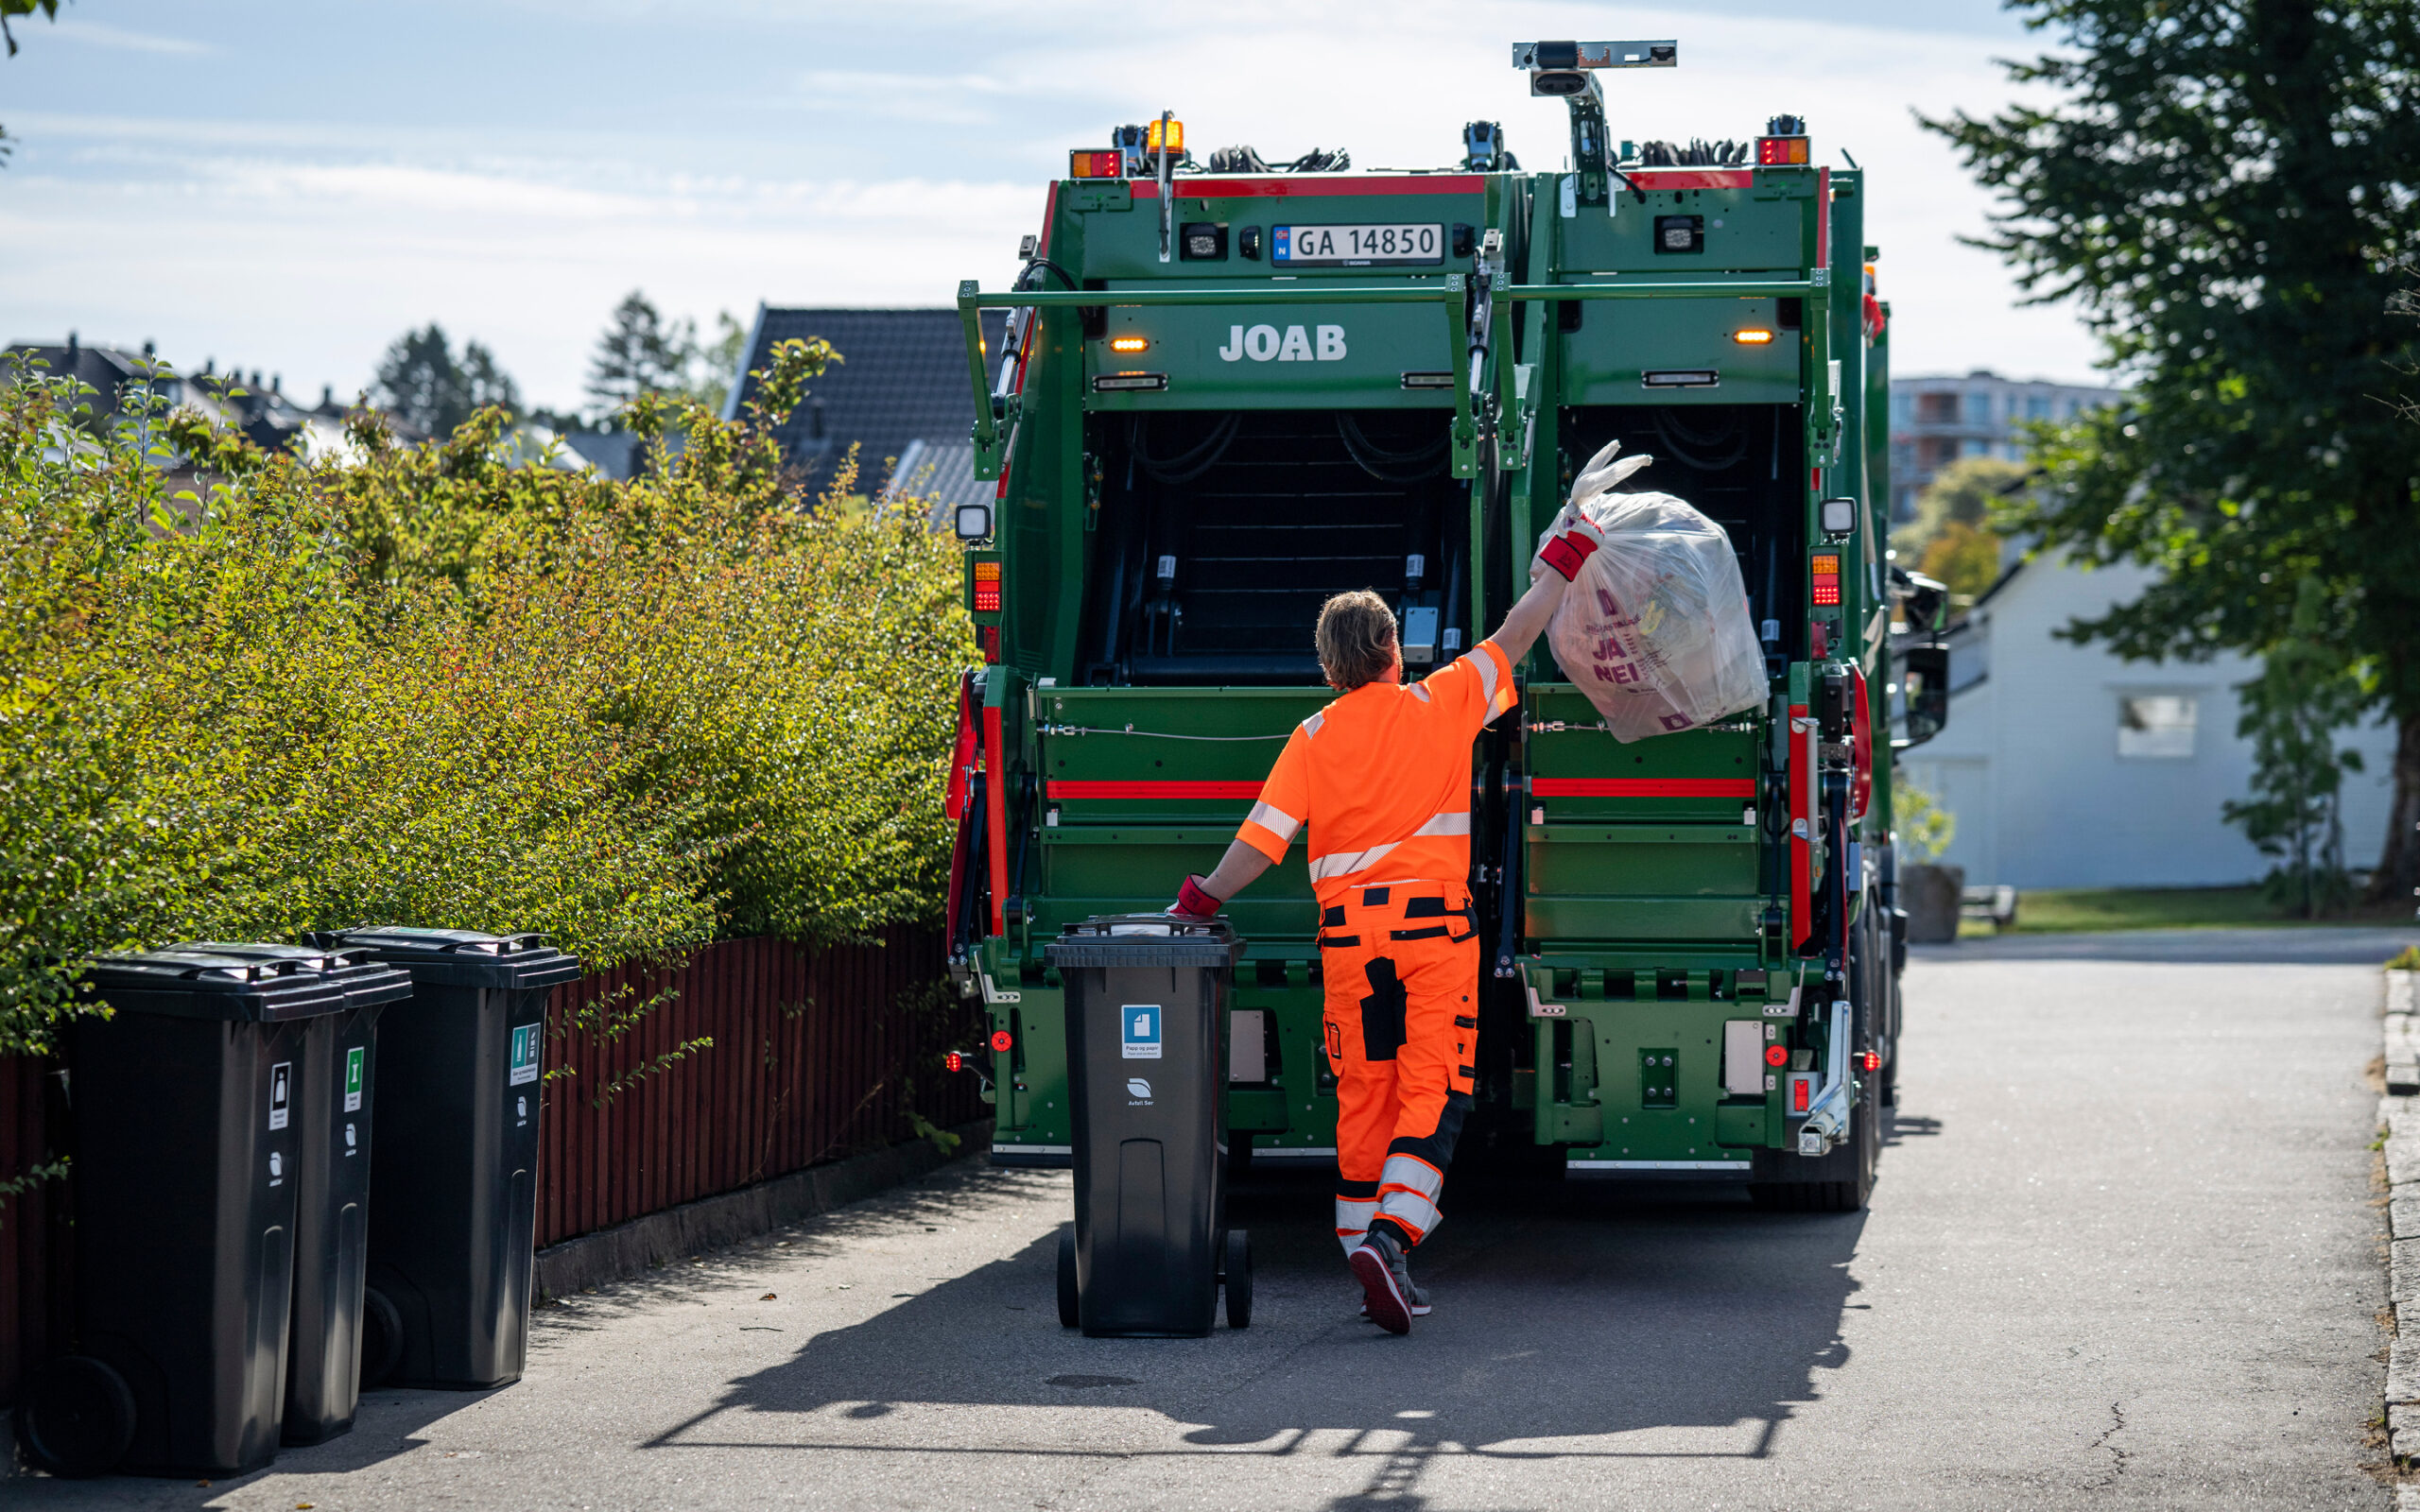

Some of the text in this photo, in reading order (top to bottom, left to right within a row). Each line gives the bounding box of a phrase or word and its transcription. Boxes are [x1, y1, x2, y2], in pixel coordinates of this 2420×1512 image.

[1278, 247, 1287, 255] N
[1298, 228, 1434, 255] GA 14850
[1219, 324, 1347, 362] JOAB
[1592, 637, 1627, 661] JA
[1593, 662, 1640, 684] NEI
